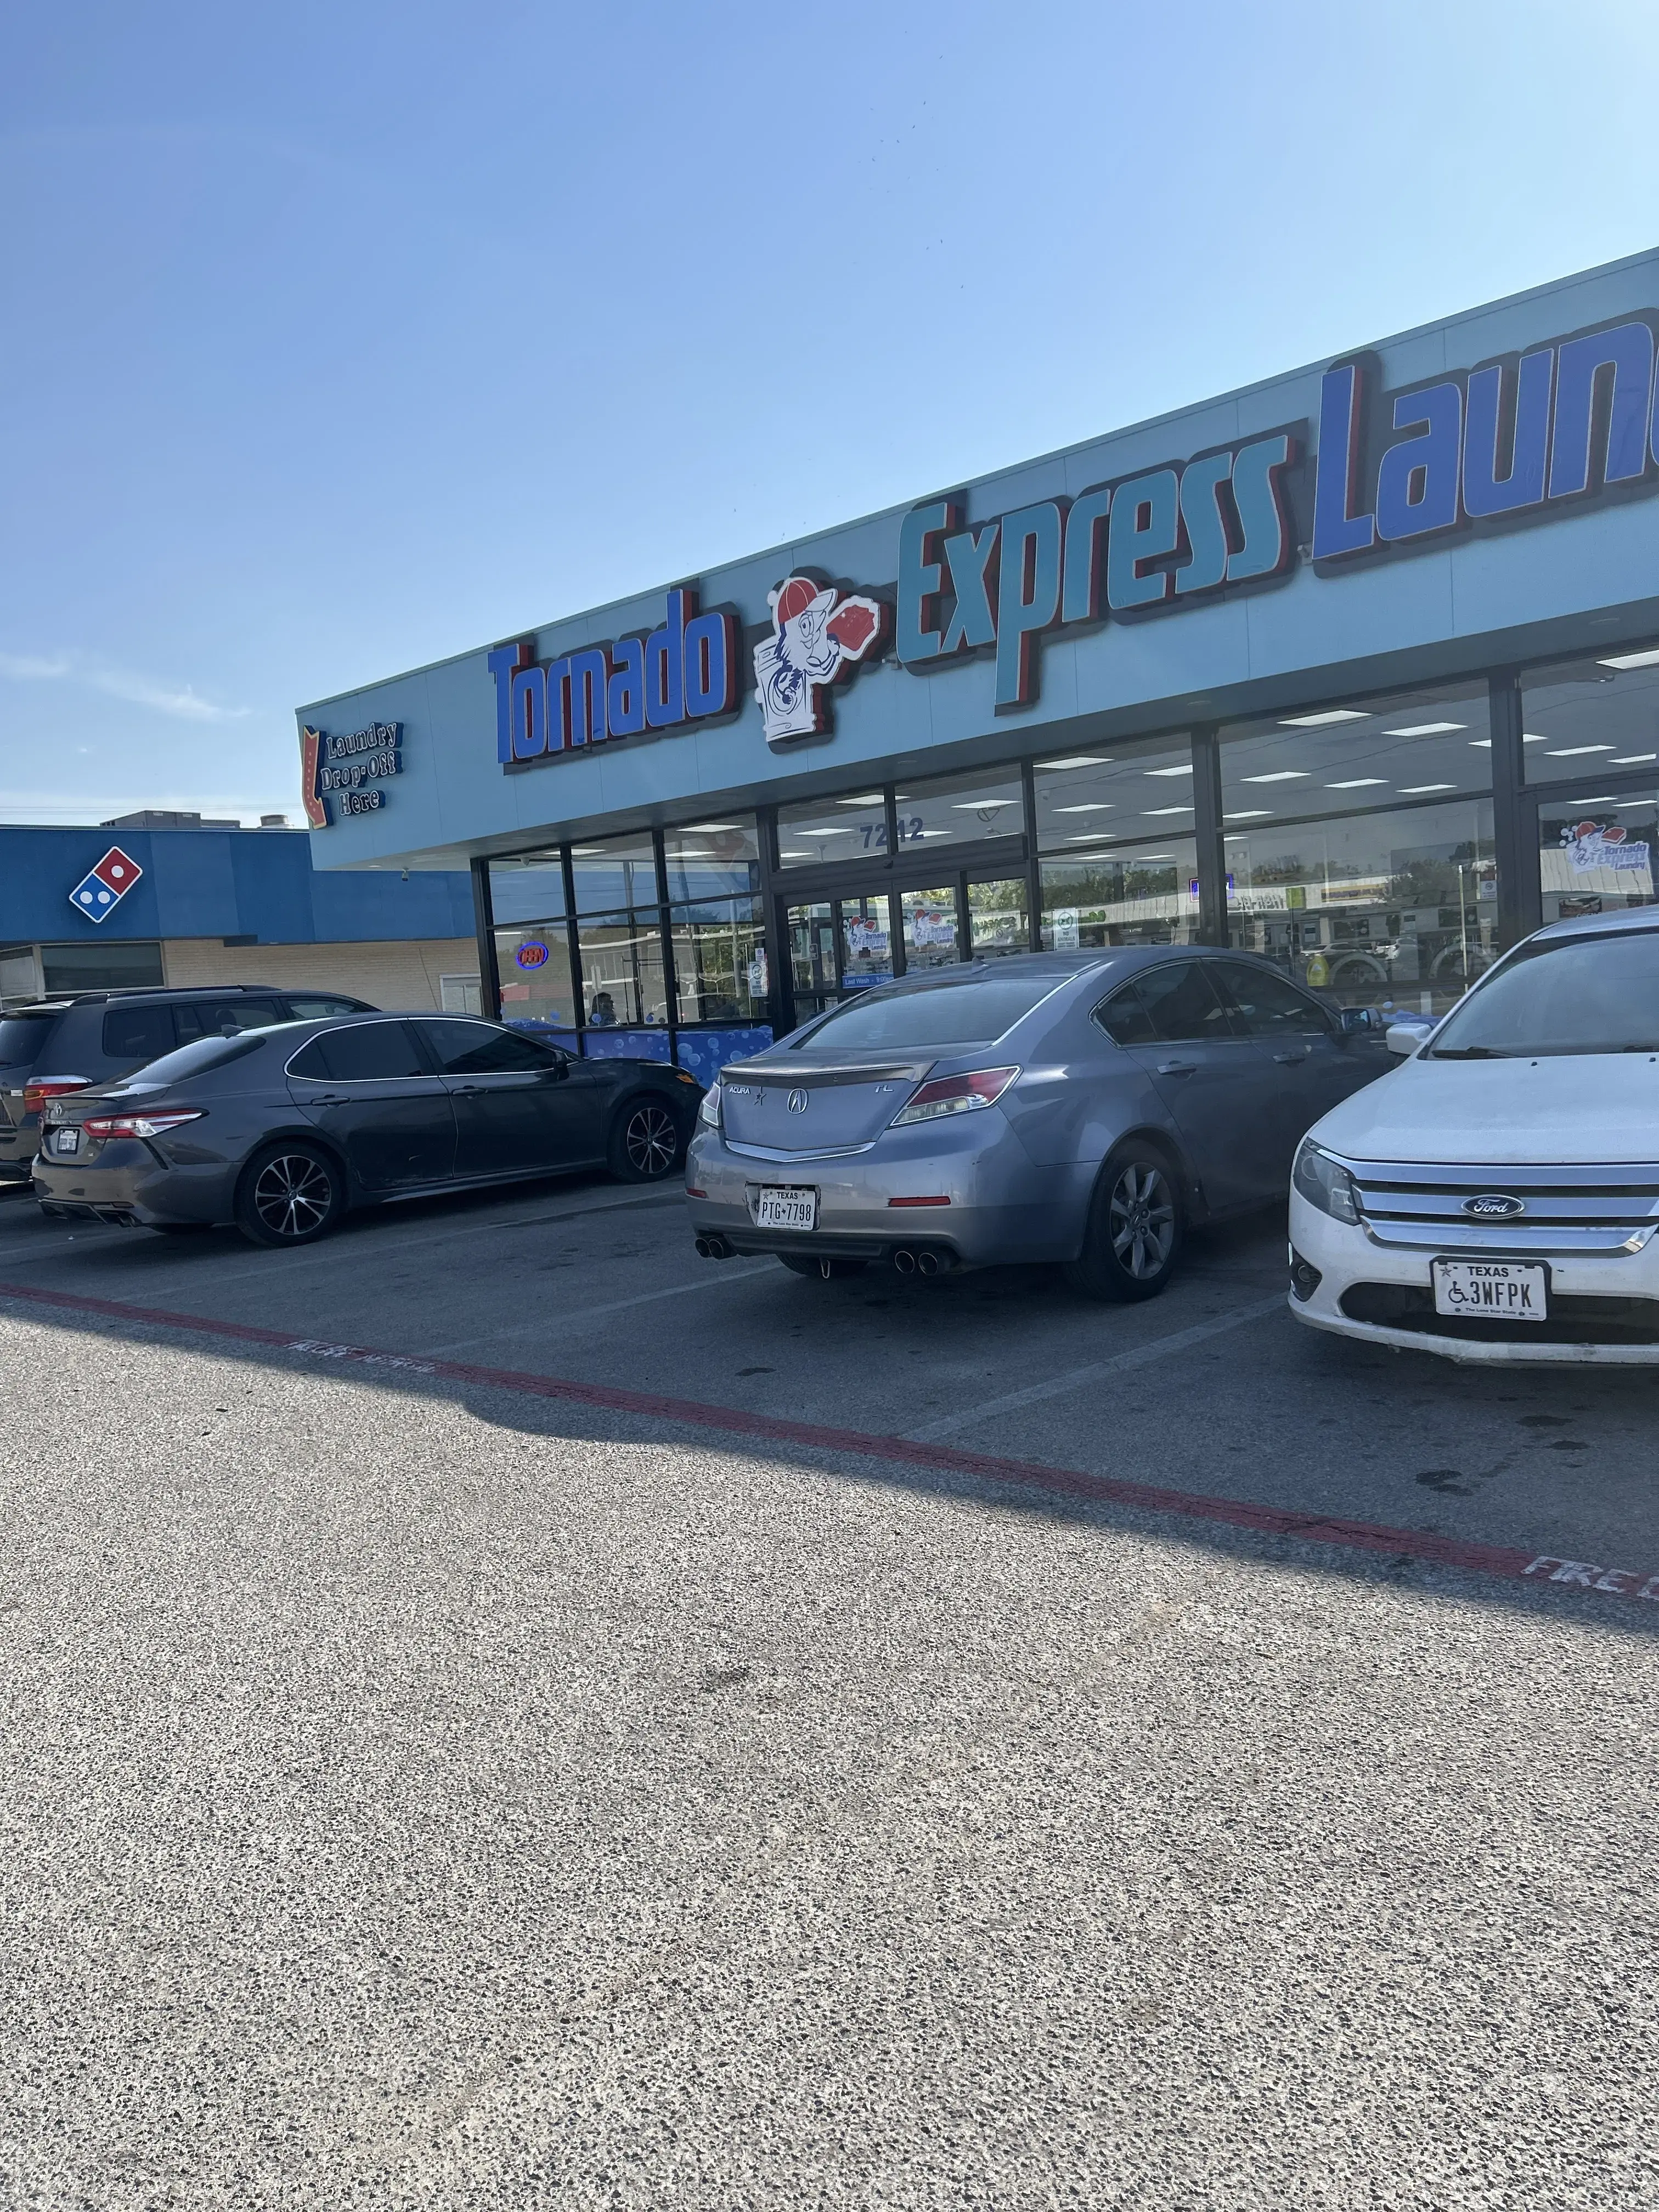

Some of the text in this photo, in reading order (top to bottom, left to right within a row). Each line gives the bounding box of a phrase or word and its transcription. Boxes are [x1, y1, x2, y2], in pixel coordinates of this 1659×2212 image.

[488, 321, 1659, 764] Tornado Express Laun
[326, 723, 397, 759] Laundry
[320, 751, 397, 790] Drop-Off
[339, 790, 380, 816] Here
[860, 817, 924, 848] 7212
[1604, 843, 1646, 855] Tornado
[874, 1085, 893, 1093] TL
[777, 1192, 798, 1200] TEXAS
[1474, 1199, 1509, 1213] Ford
[1467, 1266, 1509, 1277] TEXAS
[1470, 1281, 1532, 1308] 3WFPK
